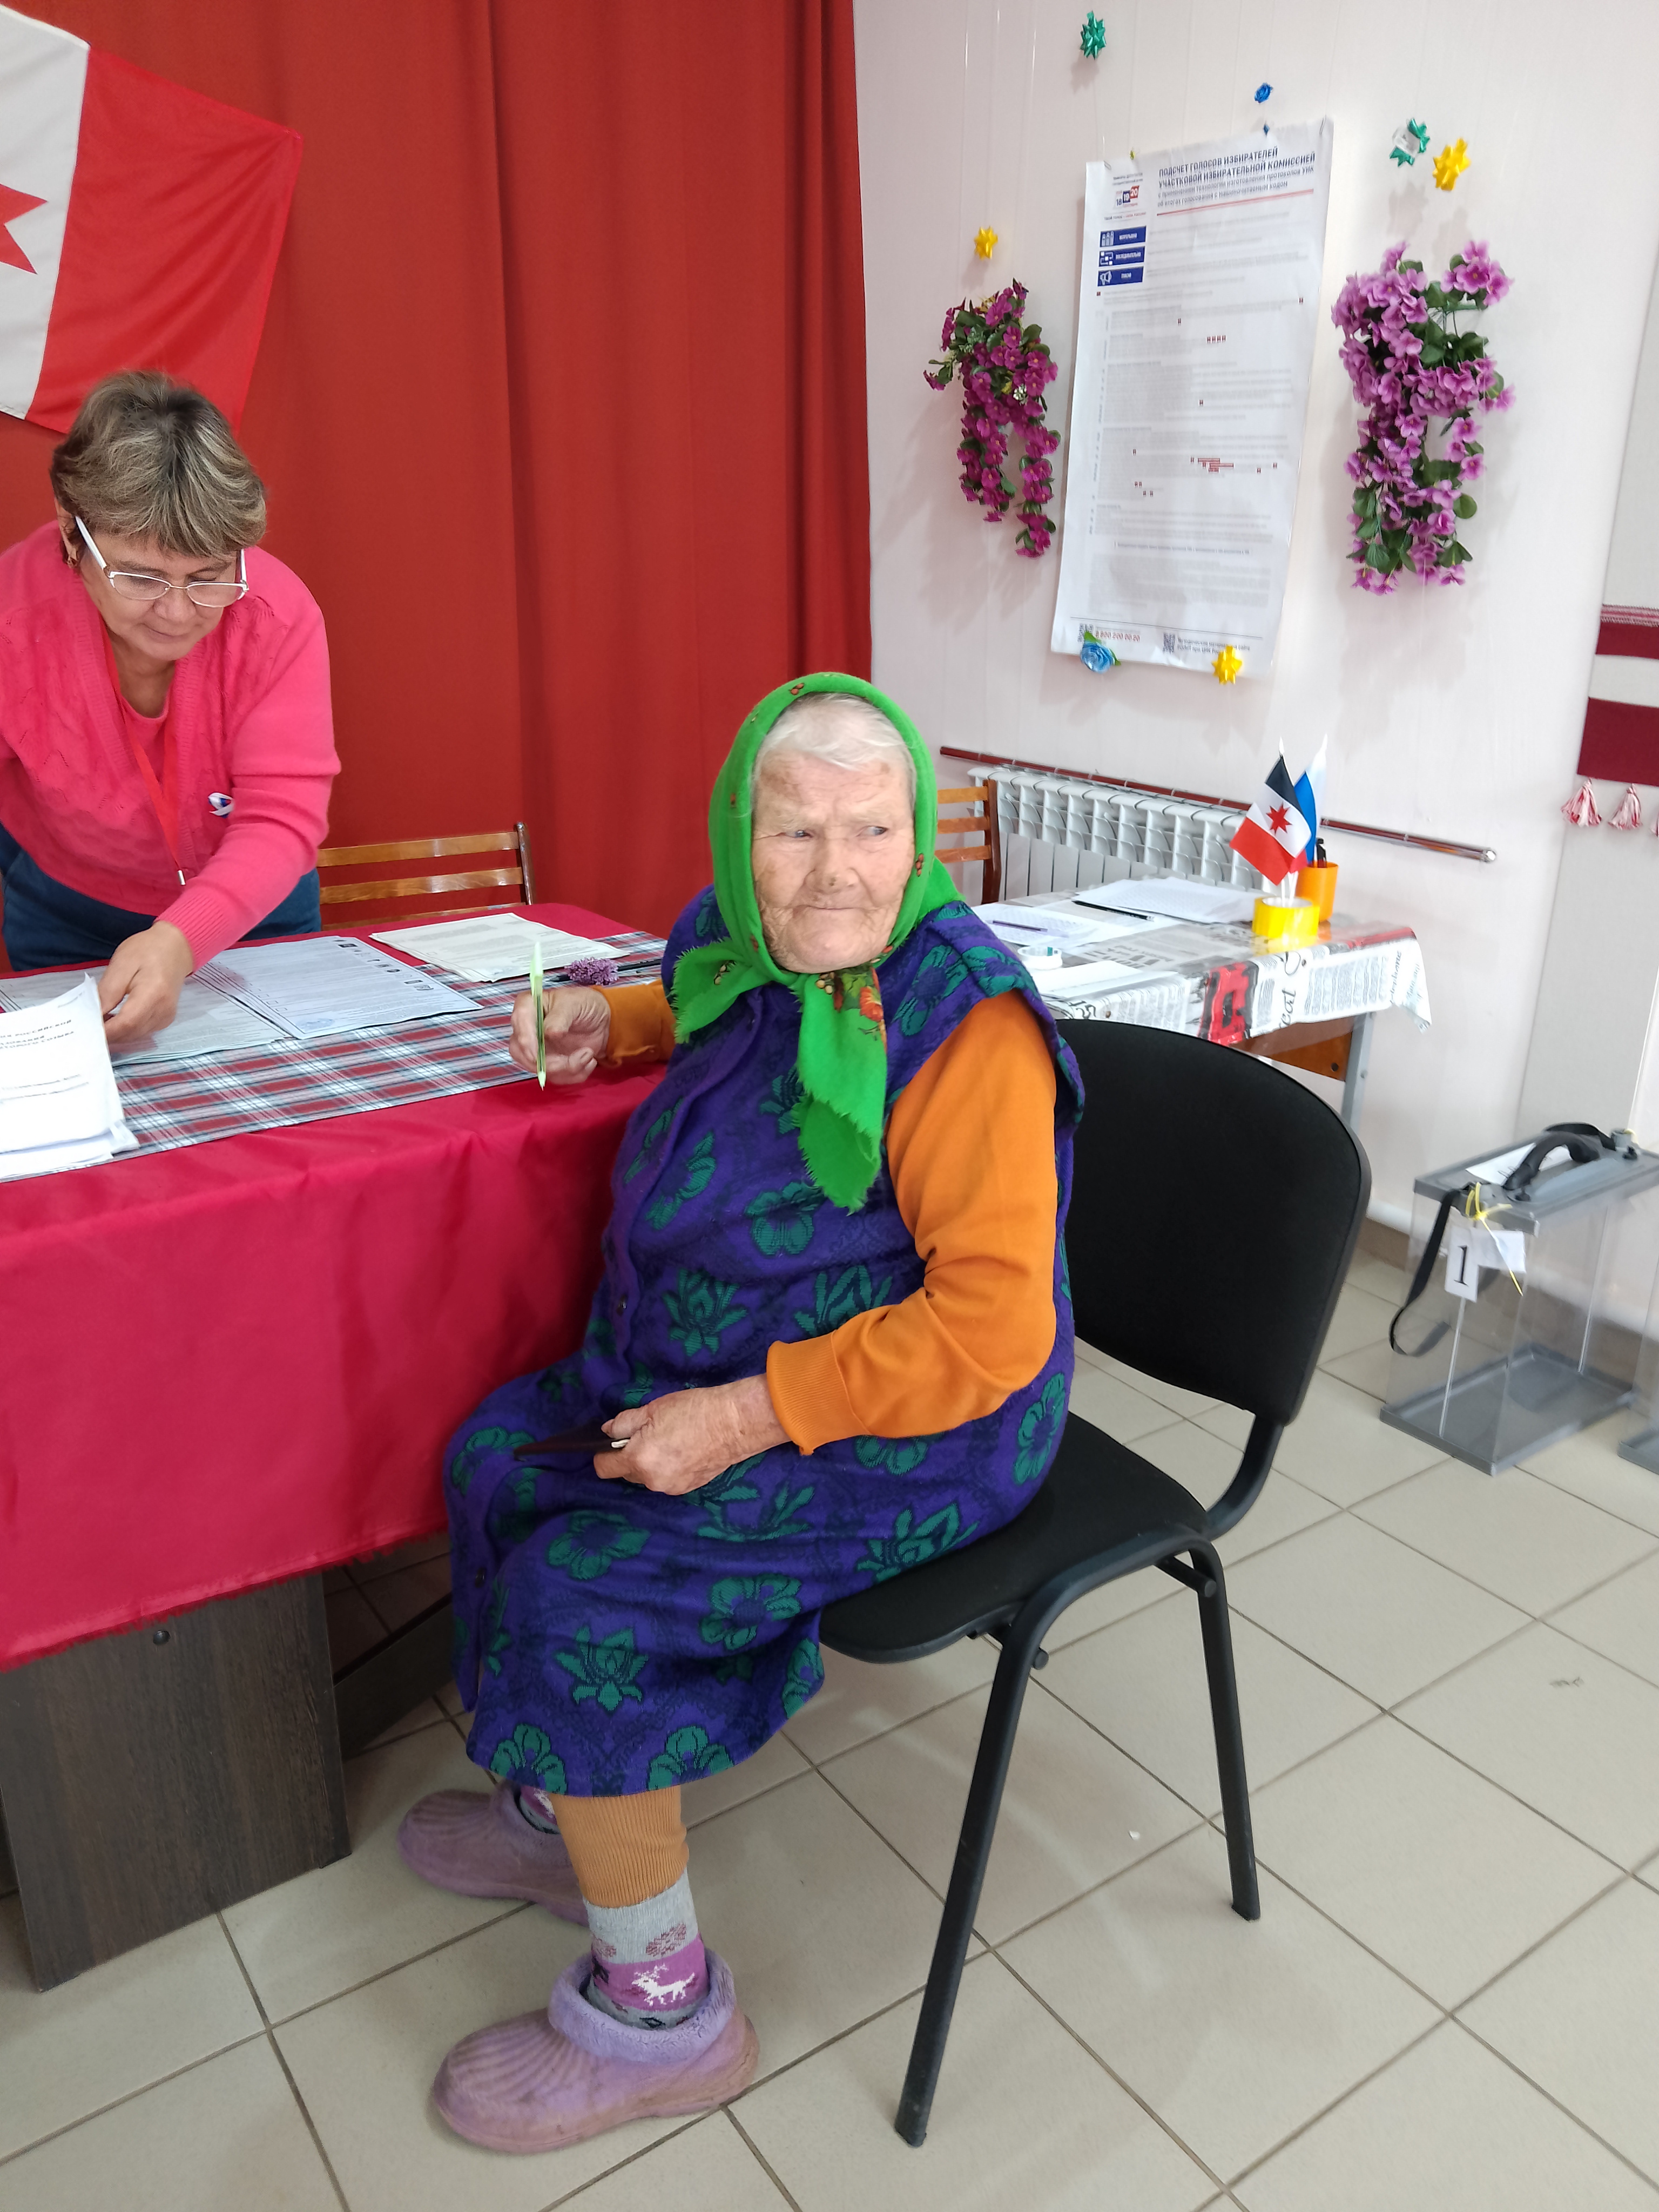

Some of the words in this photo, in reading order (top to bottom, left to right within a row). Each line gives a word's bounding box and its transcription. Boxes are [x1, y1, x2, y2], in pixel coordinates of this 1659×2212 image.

[1159, 164, 1189, 177] ПОДСЧЕТ
[1190, 158, 1222, 171] ГОЛОСОВ
[1224, 146, 1278, 165] ИЗБИРАТЕЛЕЙ
[1159, 171, 1202, 188] УЧАСТКОВОЙ
[1204, 160, 1266, 180] ИЗБИРАТЕЛЬНОЙ
[1267, 151, 1316, 170] КОМИССИЕЙ
[1302, 165, 1314, 174] УИК
[1123, 193, 1129, 201] 19
[1130, 188, 1138, 197] 20
[1454, 1244, 1469, 1287] 1
